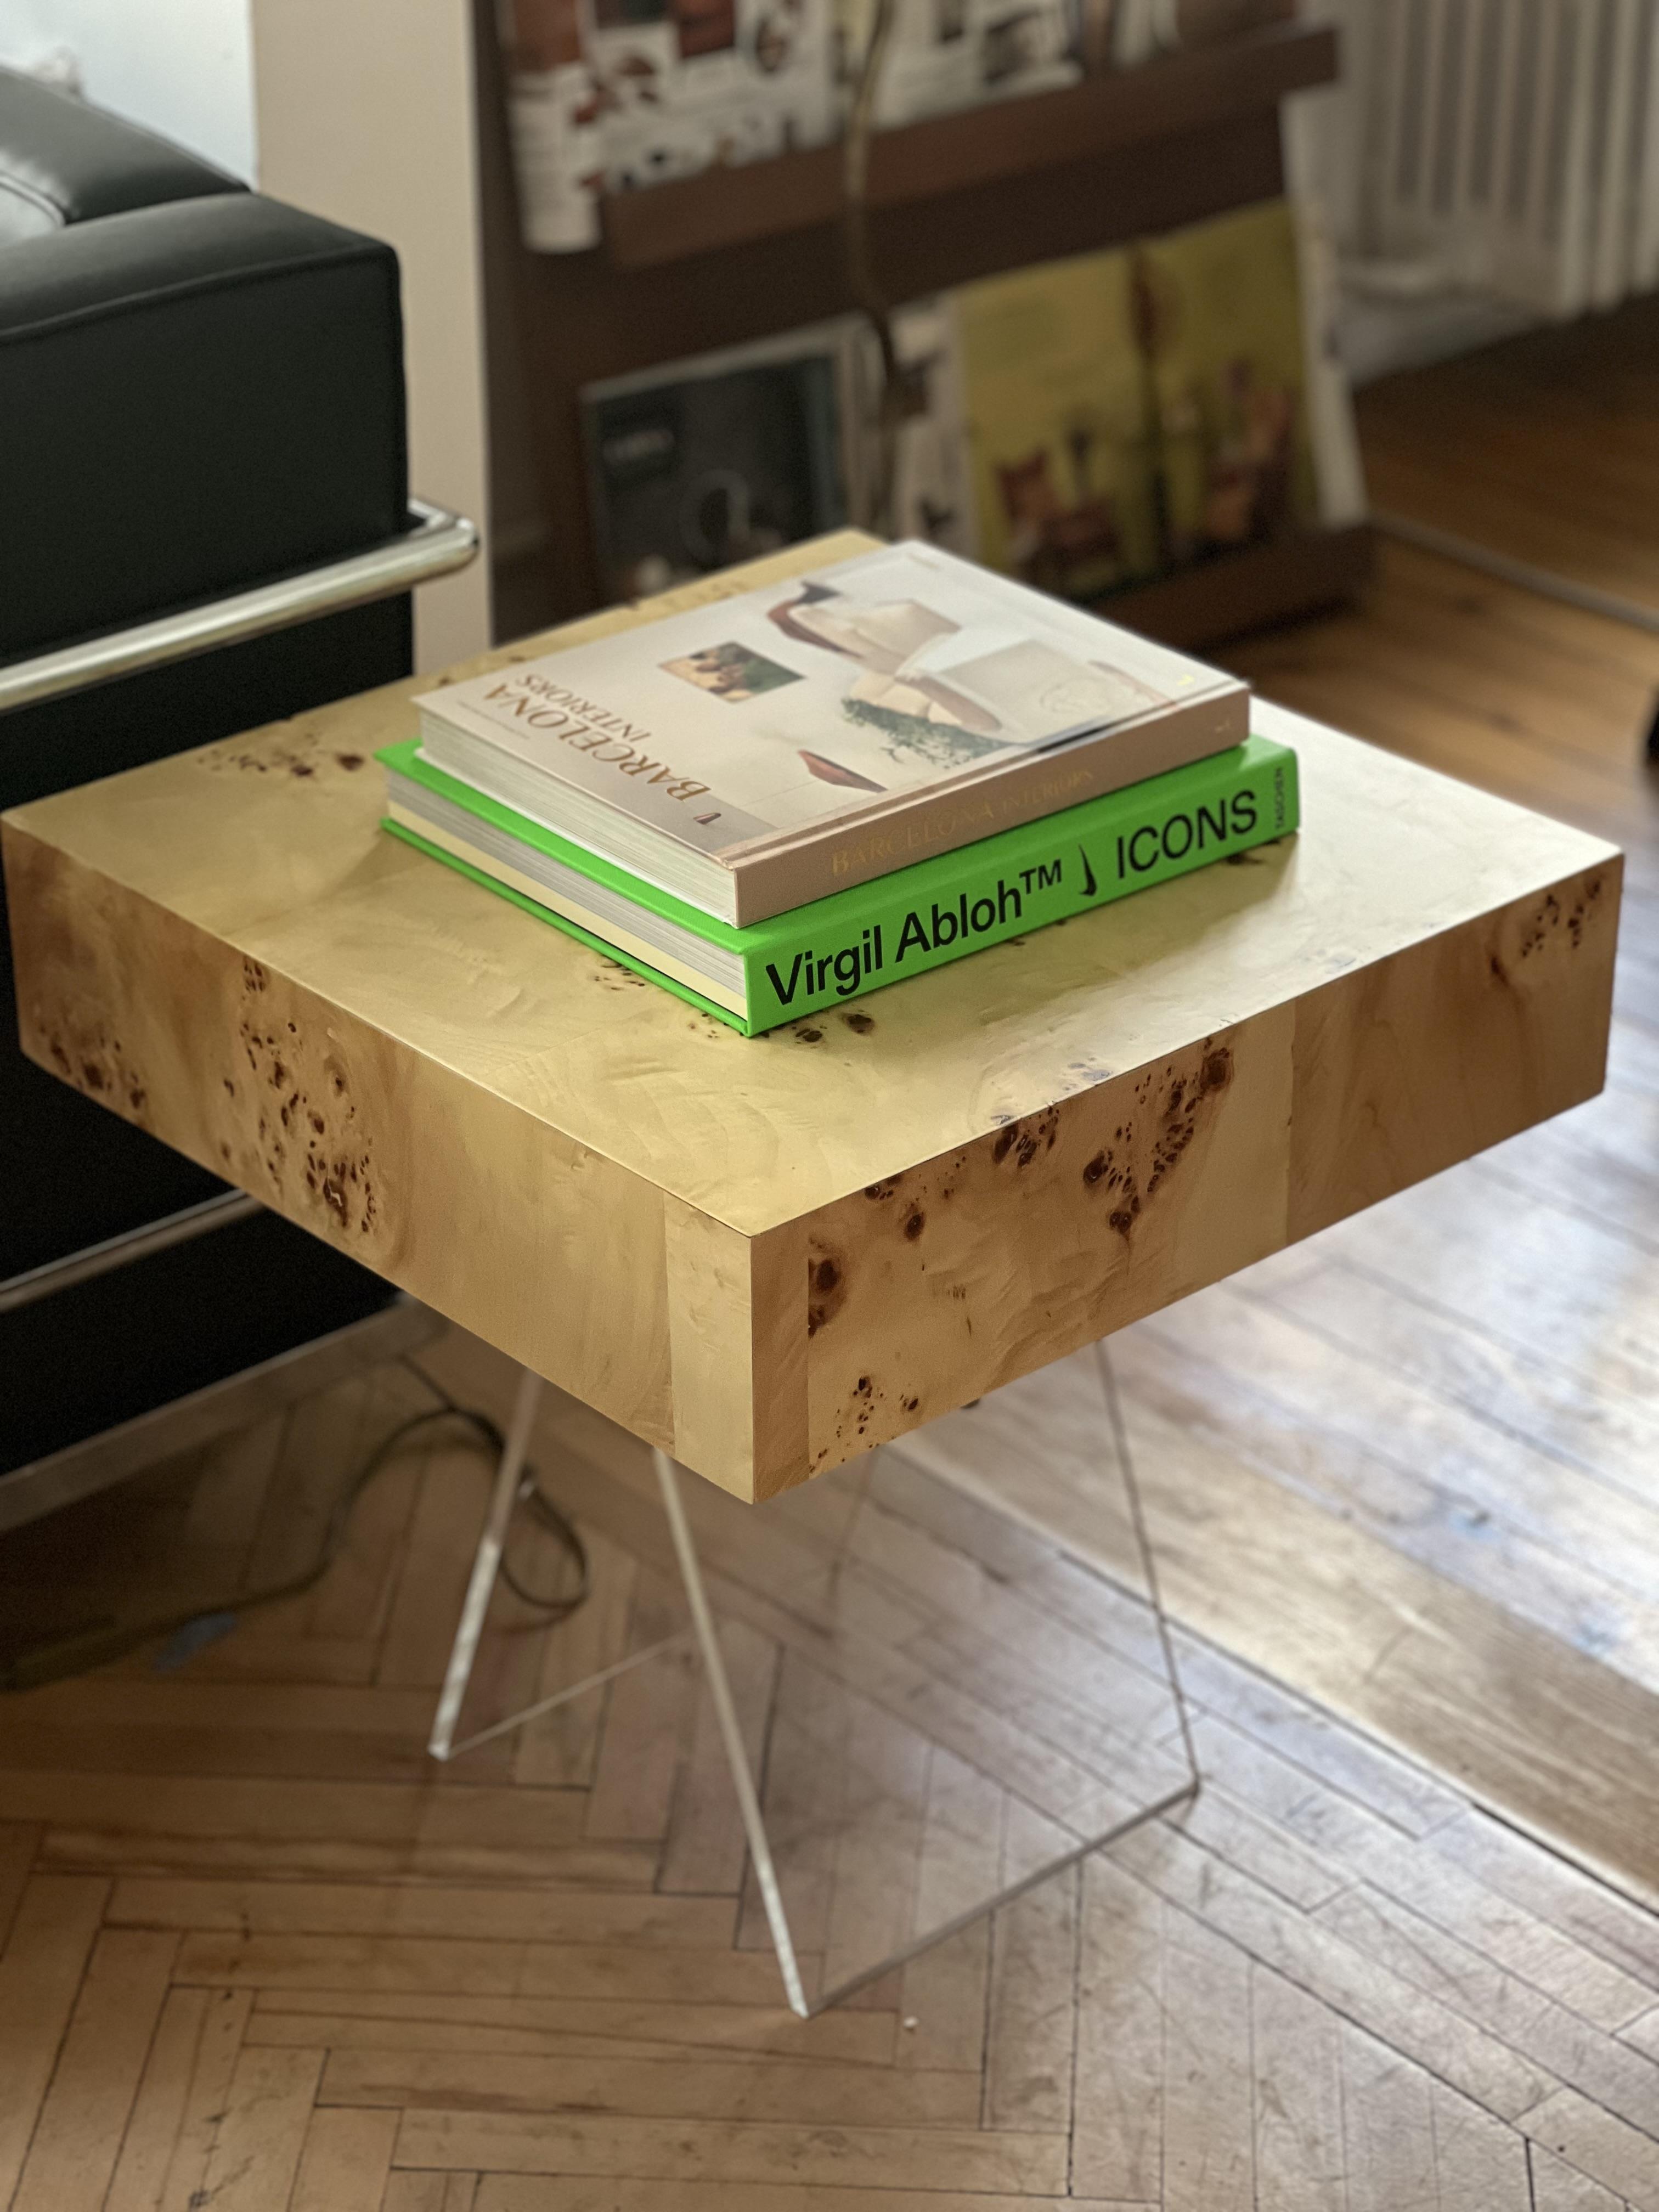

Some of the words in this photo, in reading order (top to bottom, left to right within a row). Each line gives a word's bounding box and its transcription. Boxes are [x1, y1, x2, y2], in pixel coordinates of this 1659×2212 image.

[484, 683, 712, 802] BARCELONA
[515, 674, 652, 742] INTERIORS
[765, 924, 883, 1006] Virgil
[1116, 789, 1257, 879] ICONS
